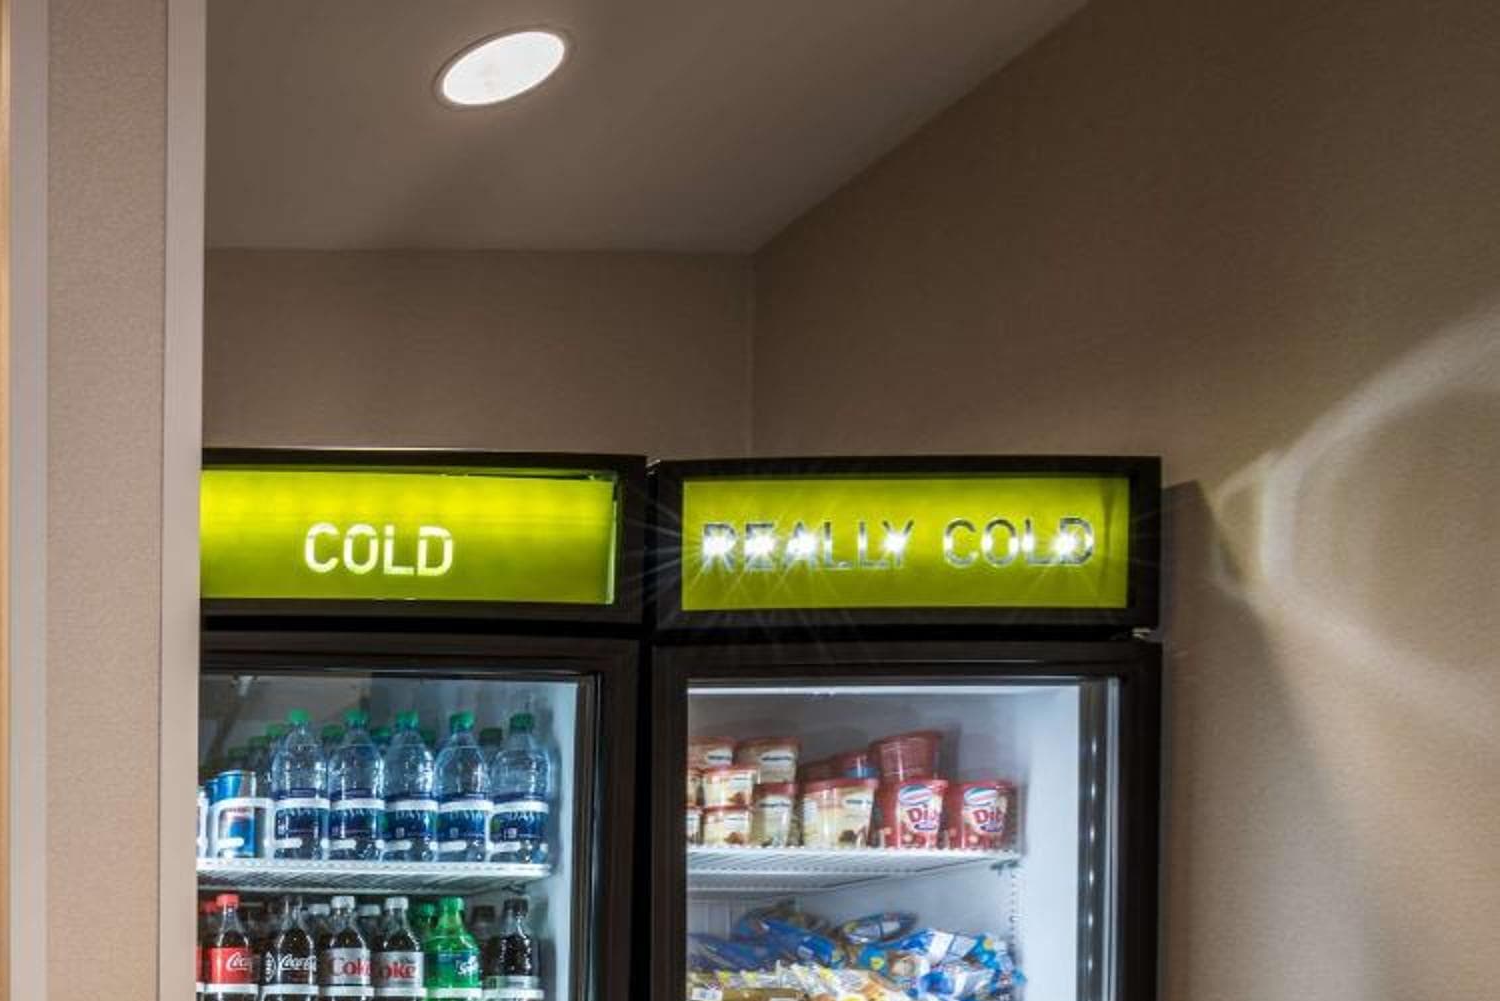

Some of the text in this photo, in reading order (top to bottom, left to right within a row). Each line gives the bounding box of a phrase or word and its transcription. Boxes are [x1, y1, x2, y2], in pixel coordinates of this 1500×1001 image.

[304, 522, 454, 577] COLD
[703, 516, 1096, 571] REALLY COLD
